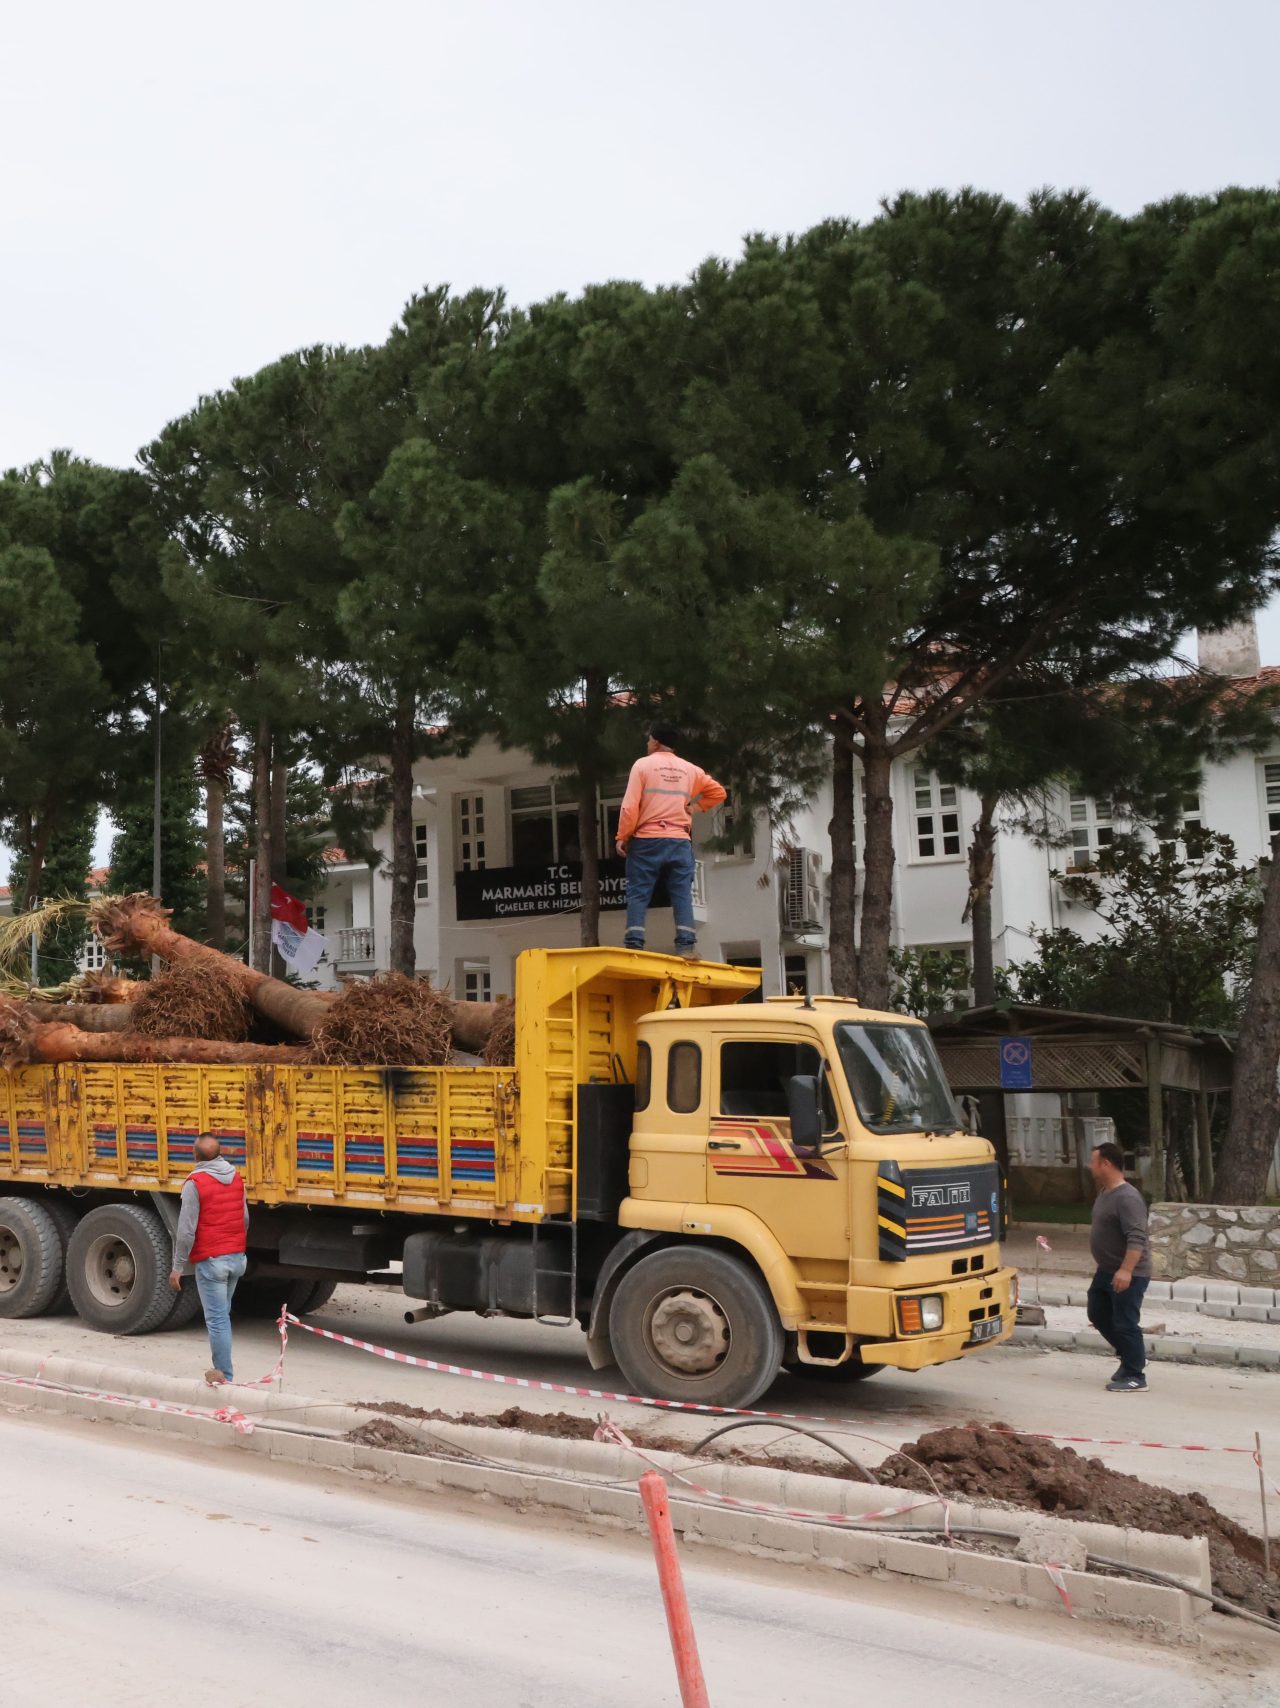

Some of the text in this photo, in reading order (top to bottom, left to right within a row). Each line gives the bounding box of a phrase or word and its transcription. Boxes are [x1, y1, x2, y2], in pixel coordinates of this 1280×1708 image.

[548, 866, 572, 879] T.C.
[482, 881, 556, 901] MARMARİS
[495, 901, 535, 914] İÇMELER
[538, 900, 550, 910] EK
[599, 895, 627, 906] İNASI
